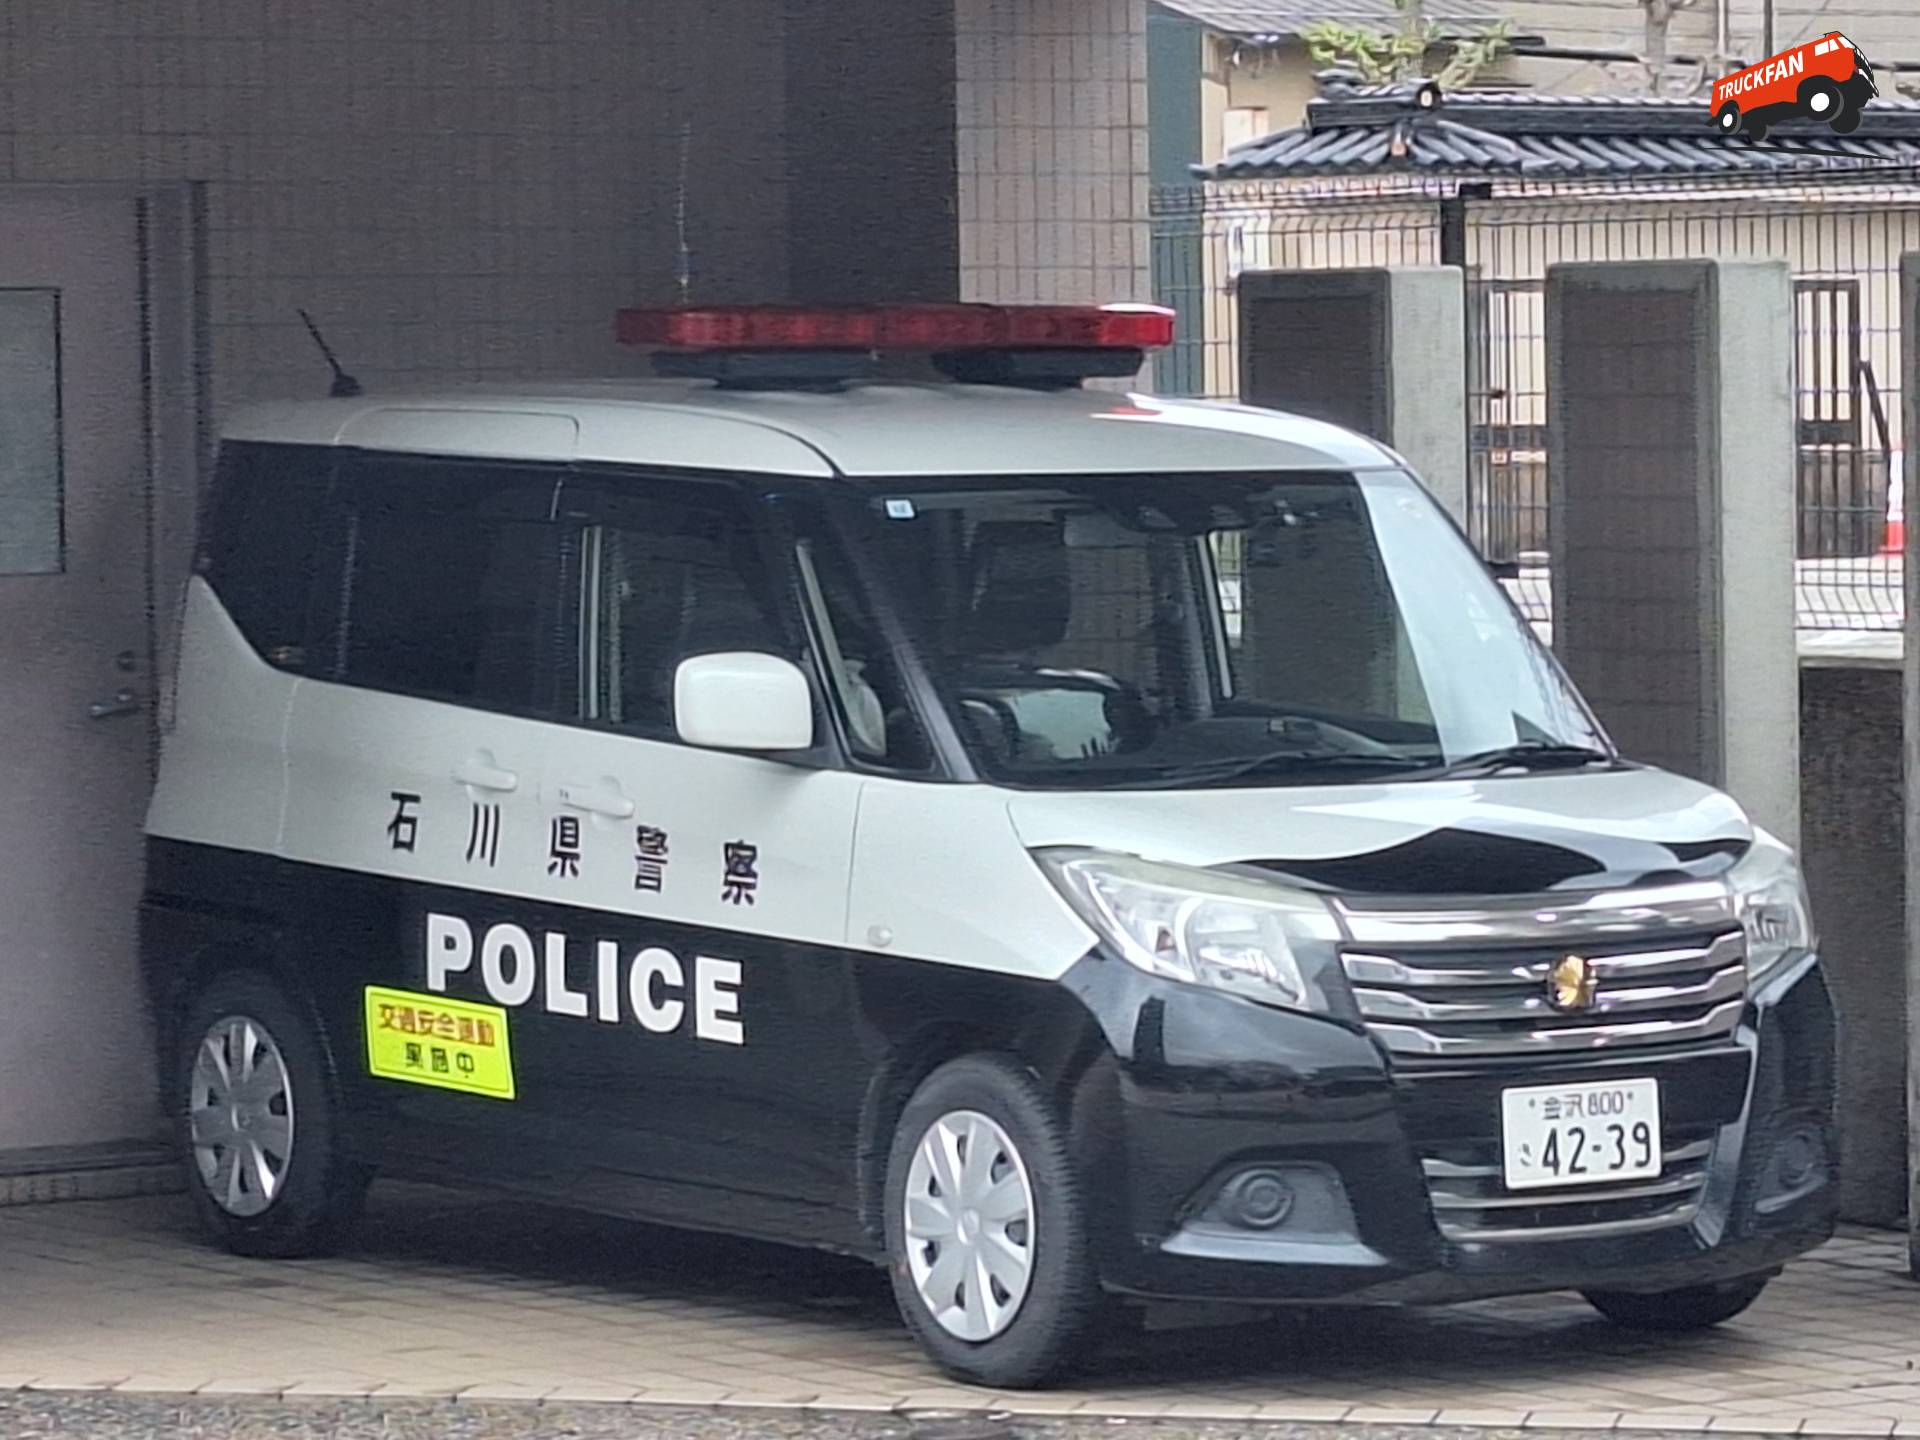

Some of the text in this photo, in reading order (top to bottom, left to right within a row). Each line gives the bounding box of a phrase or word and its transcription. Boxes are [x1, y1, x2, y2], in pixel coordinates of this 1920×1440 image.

[388, 791, 758, 905] 石川県警察
[427, 911, 744, 1044] POLICE
[1588, 1091, 1624, 1116] 800
[1542, 1121, 1651, 1176] 42-39
